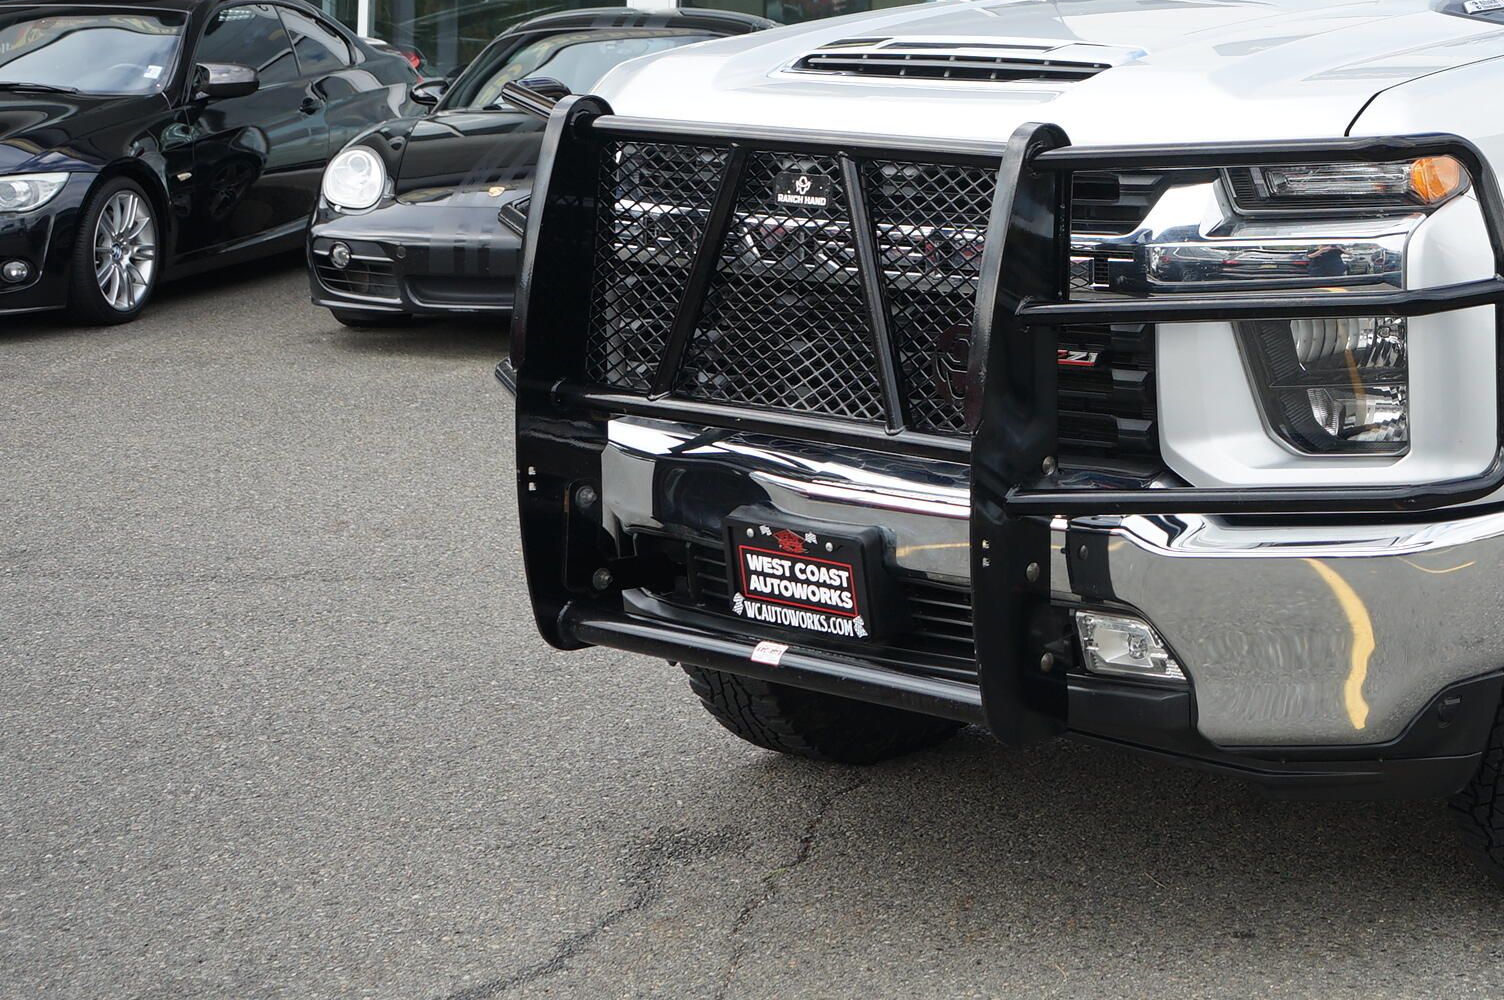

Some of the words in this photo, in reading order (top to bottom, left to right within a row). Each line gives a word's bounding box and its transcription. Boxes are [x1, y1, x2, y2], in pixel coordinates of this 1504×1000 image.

[777, 193, 804, 204] RANCH
[804, 196, 827, 206] HAND
[746, 553, 791, 577] WEST
[794, 564, 849, 588] COAST
[749, 574, 853, 609] AUTOWORKS
[744, 600, 854, 637] WCAUTOWORKS.COM
